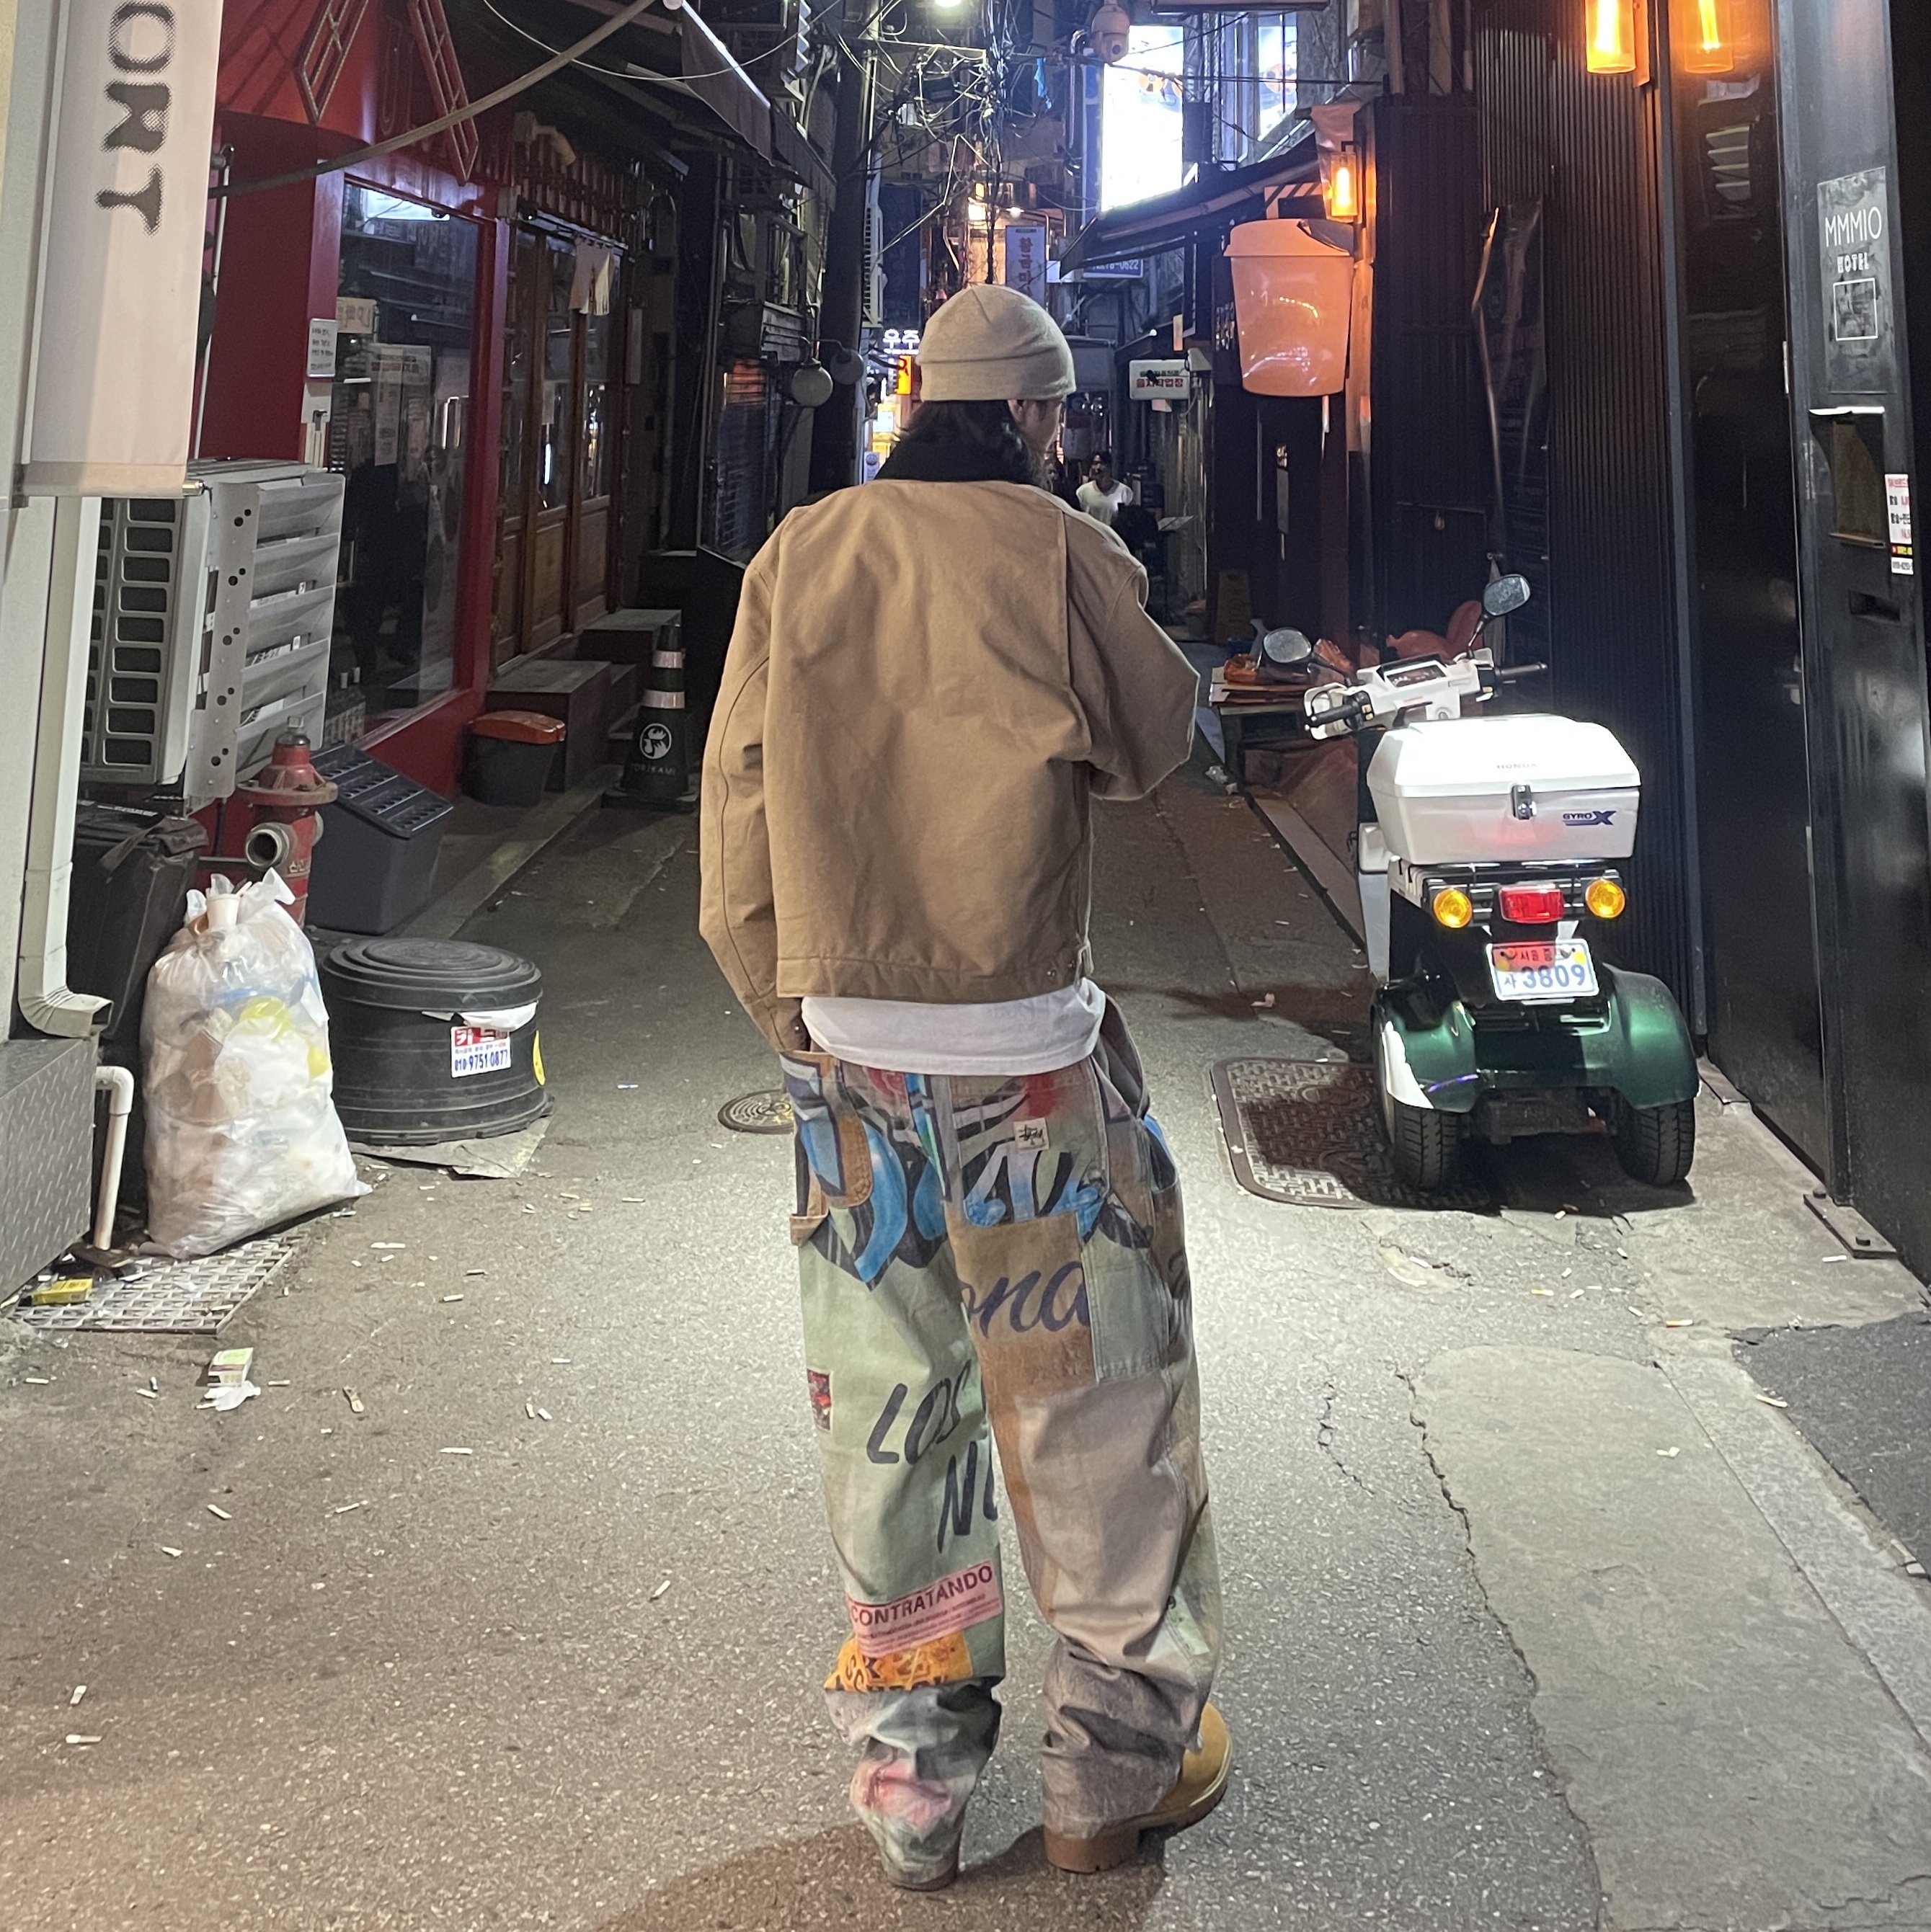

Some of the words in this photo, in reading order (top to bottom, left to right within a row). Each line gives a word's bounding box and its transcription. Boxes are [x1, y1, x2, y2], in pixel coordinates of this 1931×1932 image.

[1824, 206, 1882, 247] MMMIO
[1837, 251, 1870, 273] HOTEL
[1521, 963, 1586, 989] 3809
[851, 1565, 994, 1626] CONTRATANDO
